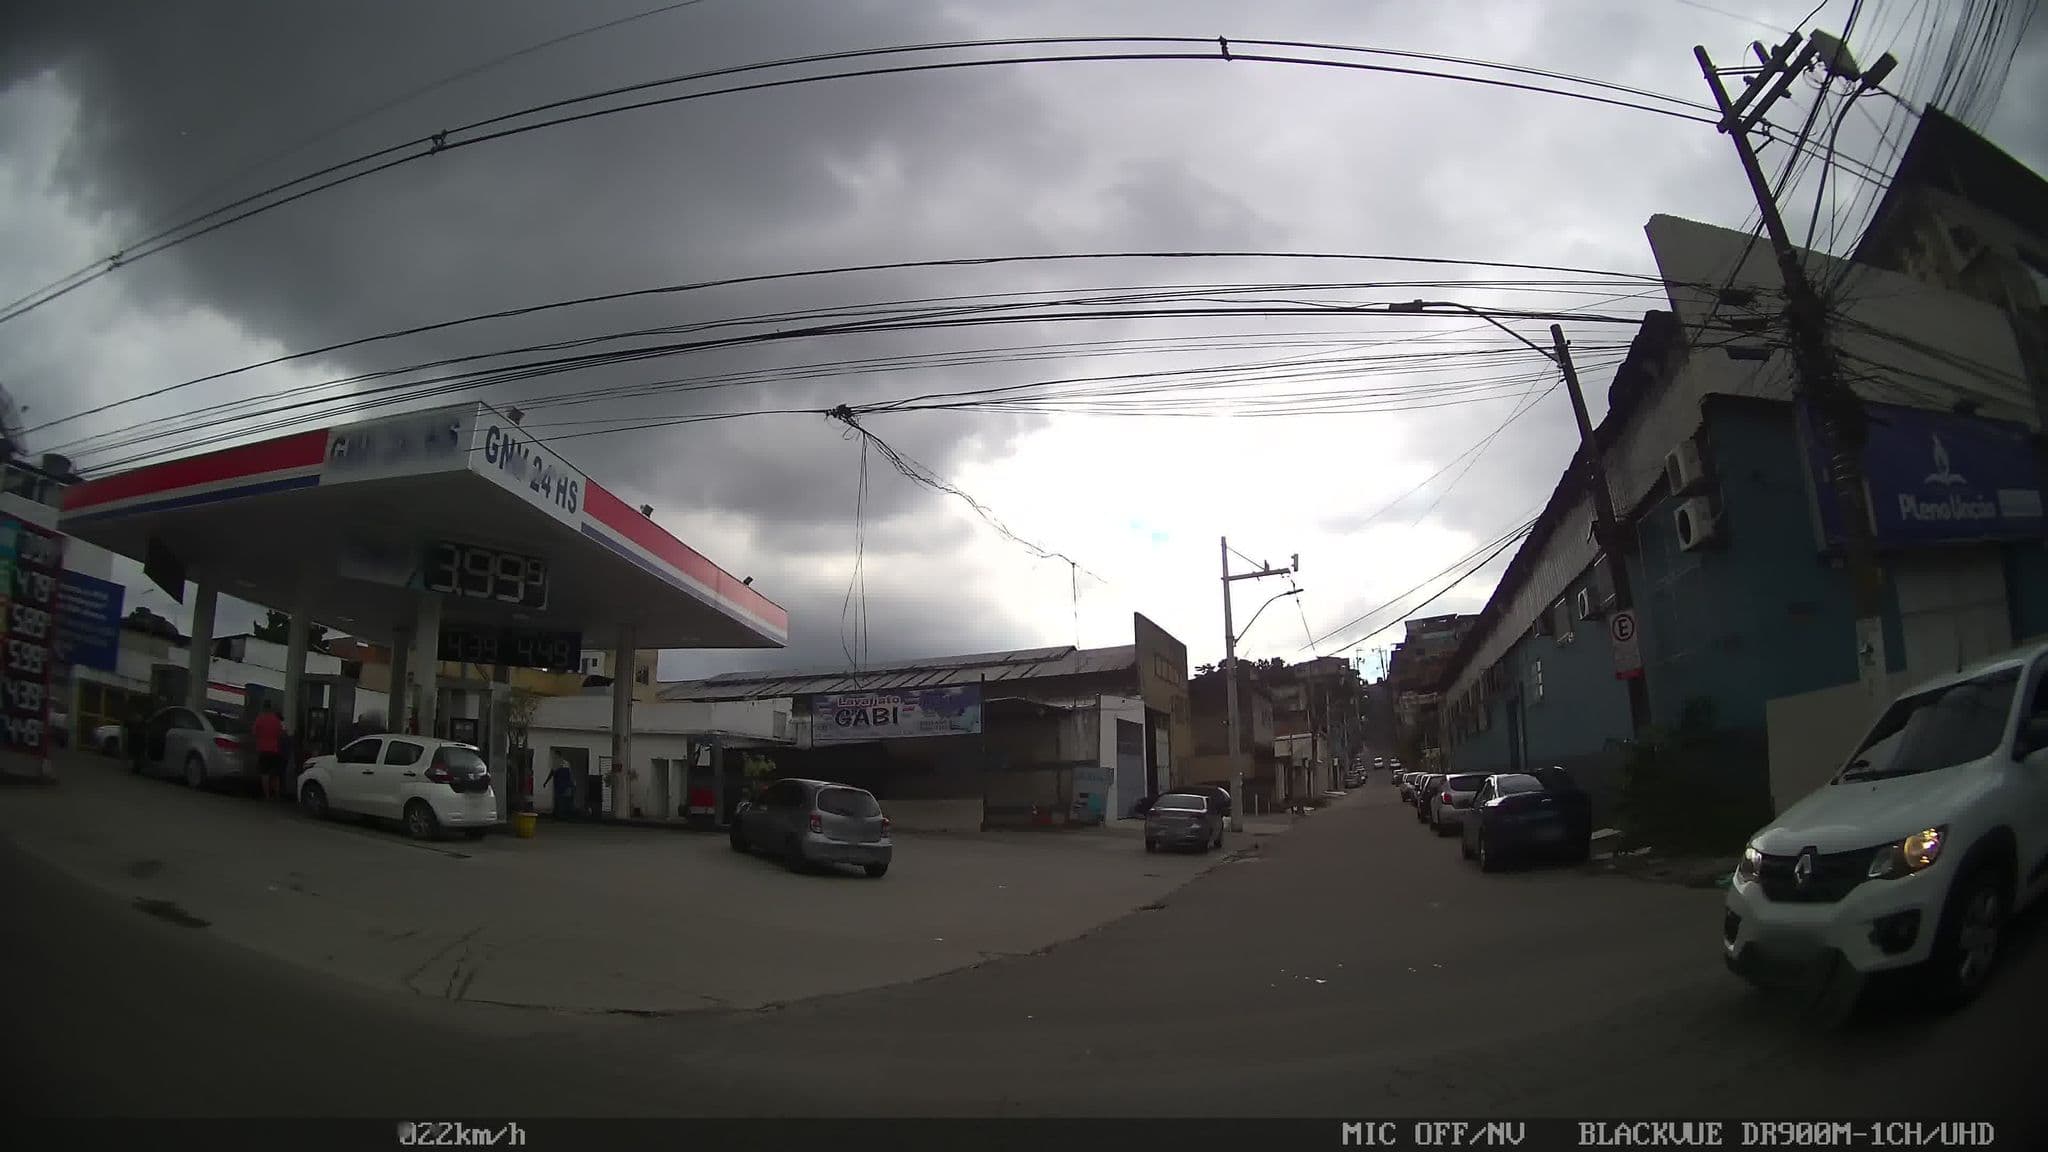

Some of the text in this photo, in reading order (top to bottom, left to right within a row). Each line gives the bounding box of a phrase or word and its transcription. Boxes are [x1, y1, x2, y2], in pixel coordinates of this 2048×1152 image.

[555, 476, 578, 514] HS
[1617, 618, 1629, 637] E
[835, 706, 898, 726] GABI
